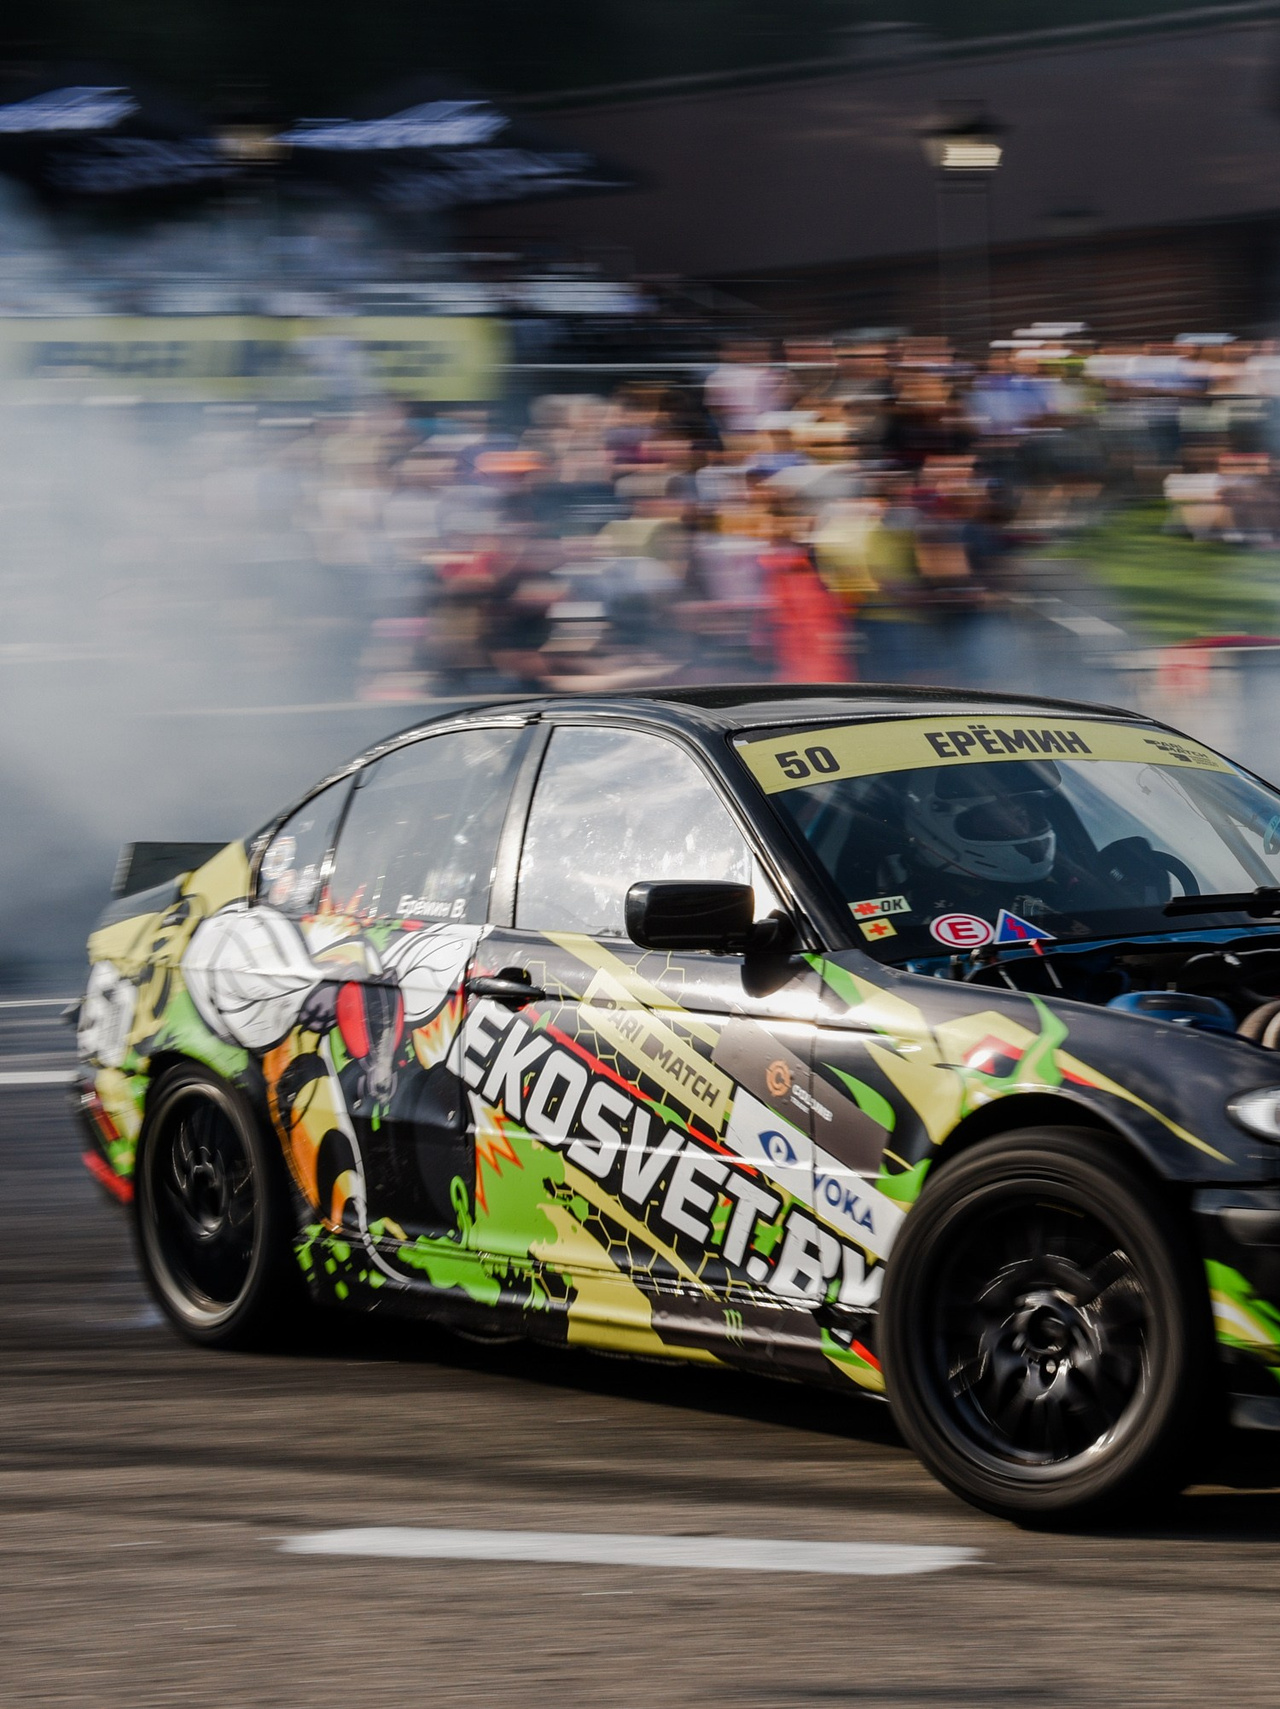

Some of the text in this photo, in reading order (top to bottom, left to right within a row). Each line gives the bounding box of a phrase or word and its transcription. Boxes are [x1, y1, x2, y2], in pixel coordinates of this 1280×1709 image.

[923, 724, 1093, 759] ЕРЁМИН
[774, 745, 841, 780] 50
[880, 898, 904, 913] OK
[946, 920, 980, 941] E
[589, 987, 721, 1109] PARI MATCH
[812, 1171, 877, 1236] VOKA
